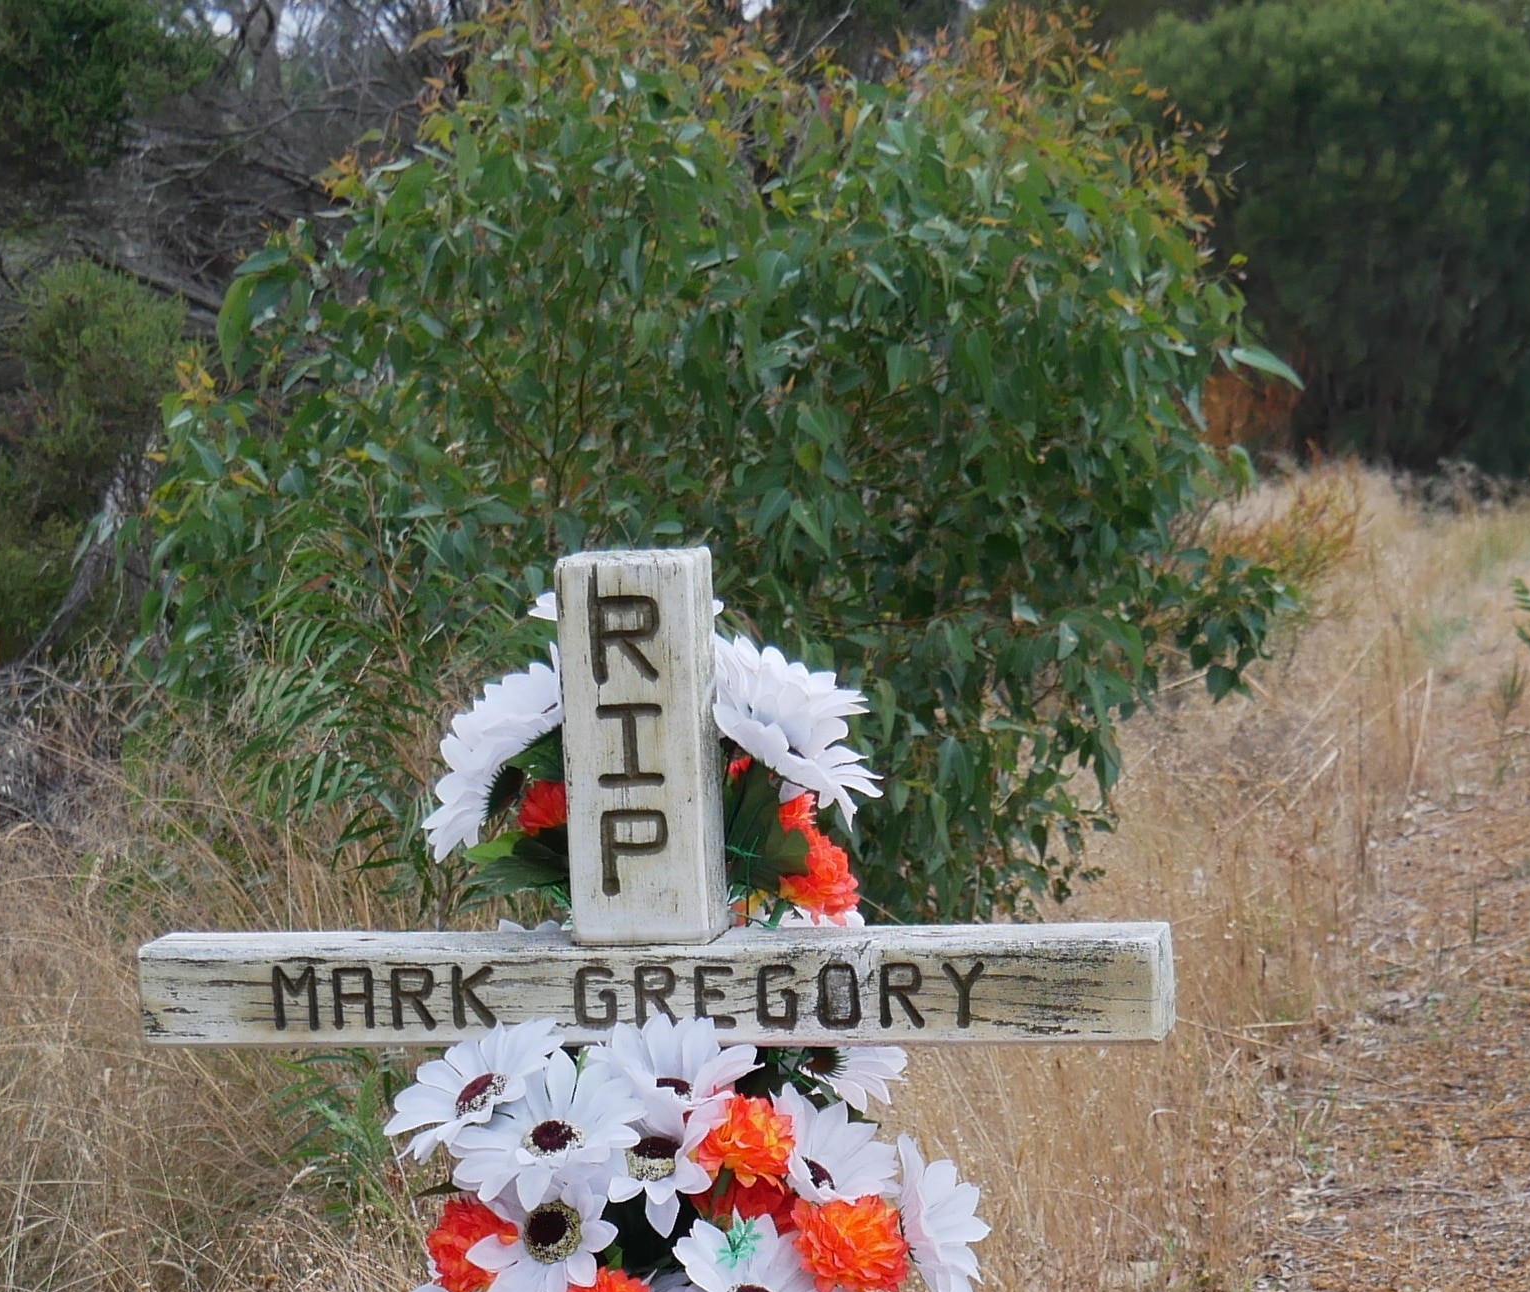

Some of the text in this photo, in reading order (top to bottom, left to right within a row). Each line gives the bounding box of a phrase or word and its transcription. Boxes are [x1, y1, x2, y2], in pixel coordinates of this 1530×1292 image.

[588, 592, 668, 896] RIP
[272, 961, 985, 1031] MARK GREGORY
